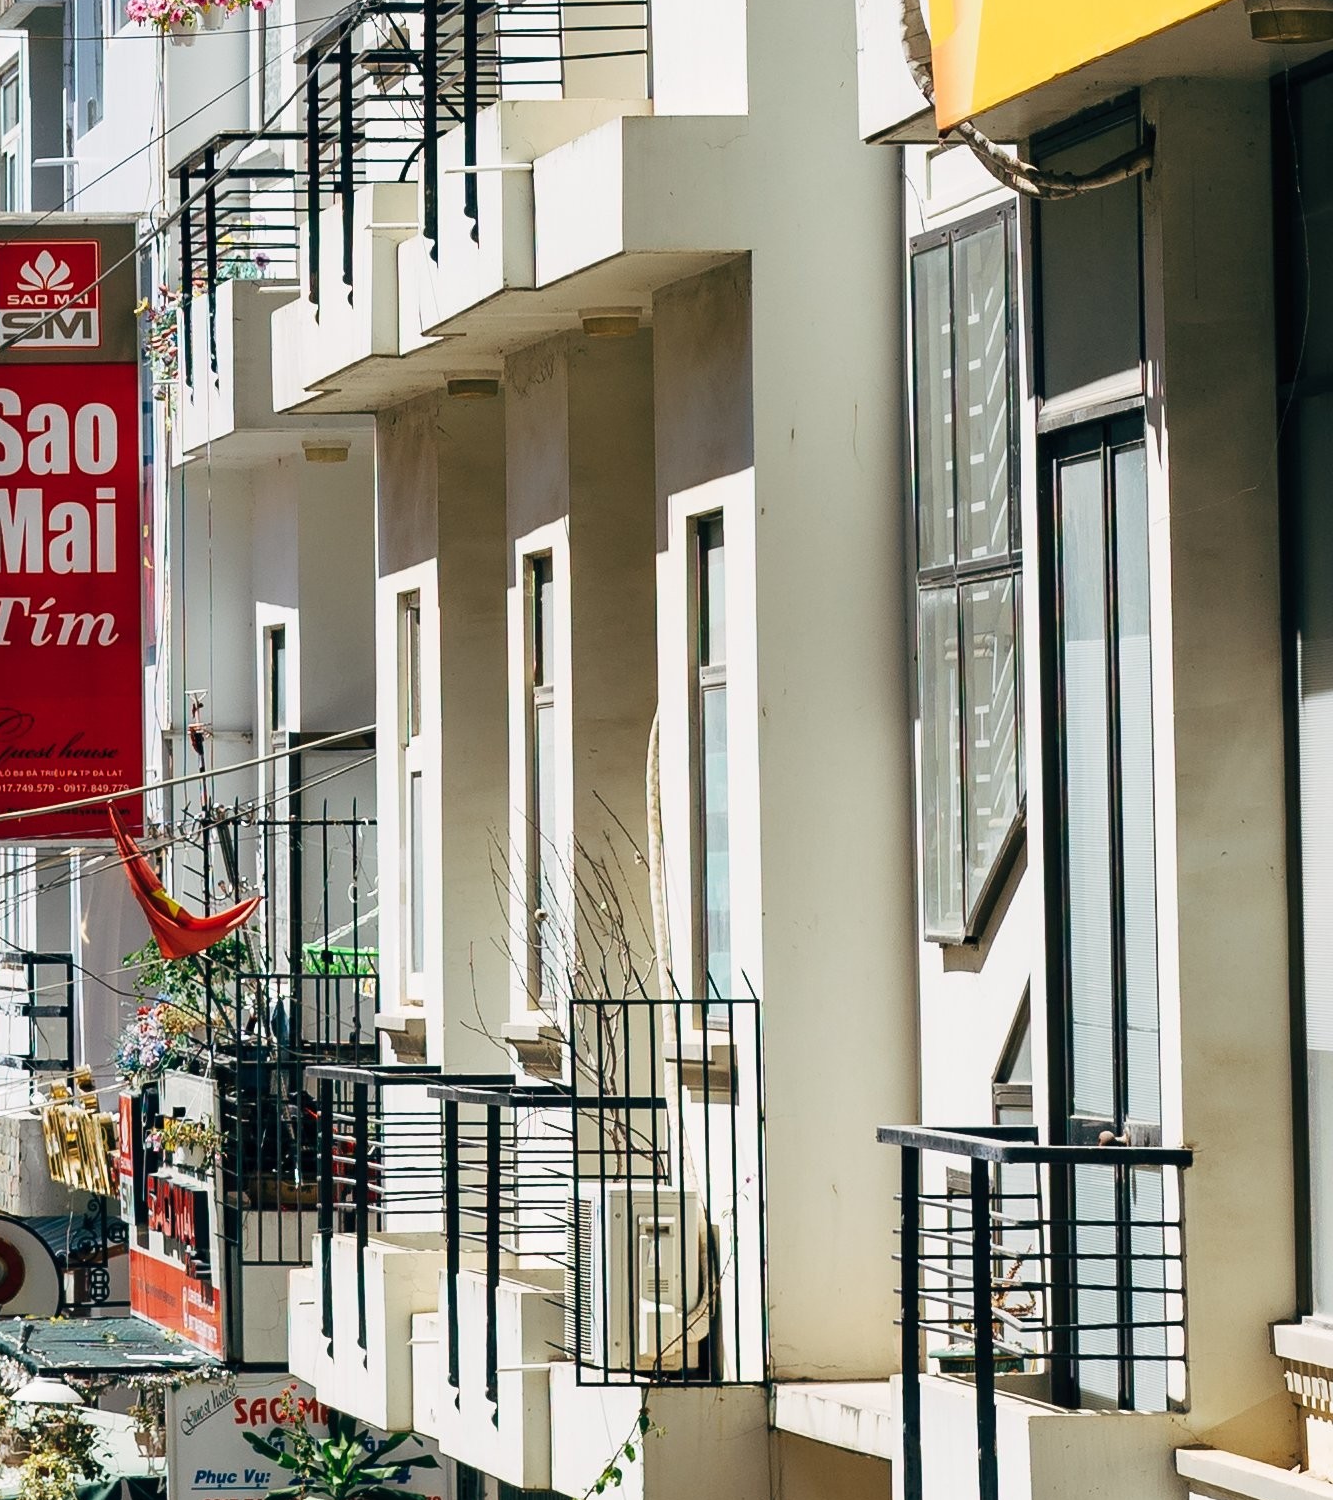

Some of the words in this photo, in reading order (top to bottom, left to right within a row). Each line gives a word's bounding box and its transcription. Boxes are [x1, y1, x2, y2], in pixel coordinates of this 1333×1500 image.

[7, 295, 48, 305] SAO
[2, 311, 92, 340] SM
[194, 1468, 238, 1489] Phục
[244, 1468, 271, 1488] Vụ:
